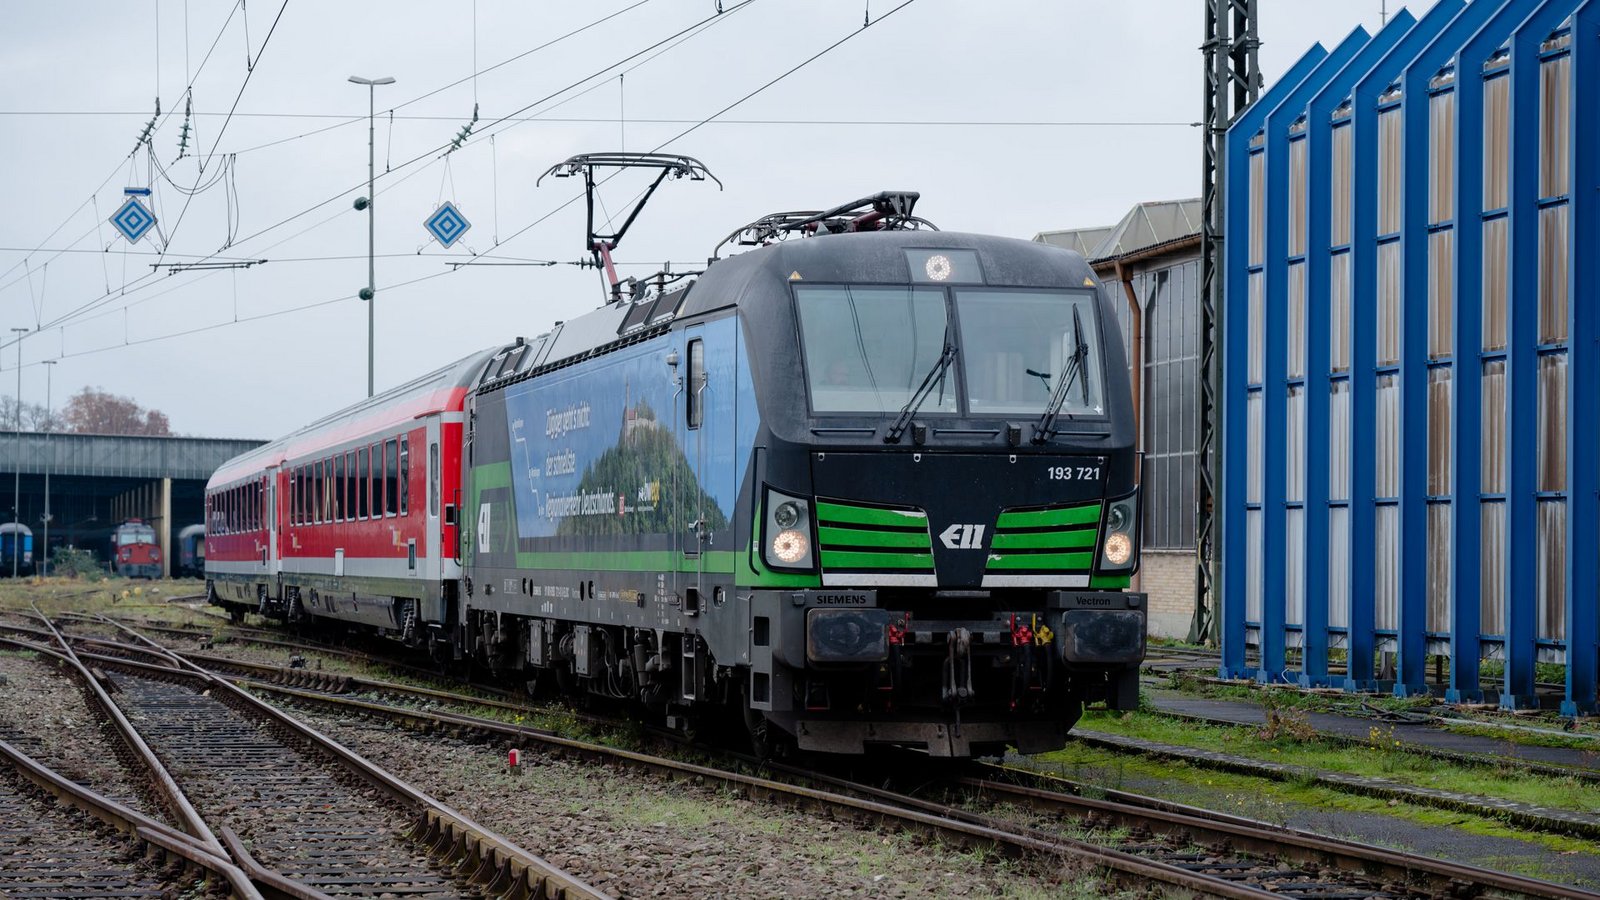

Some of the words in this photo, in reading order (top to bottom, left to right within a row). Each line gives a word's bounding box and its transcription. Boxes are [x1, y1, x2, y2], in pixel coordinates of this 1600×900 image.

[1047, 467, 1072, 480] 193
[1076, 467, 1100, 480] 721
[709, 532, 714, 545] 2
[817, 594, 866, 605] SIEMENS
[1076, 595, 1111, 606] Vectron
